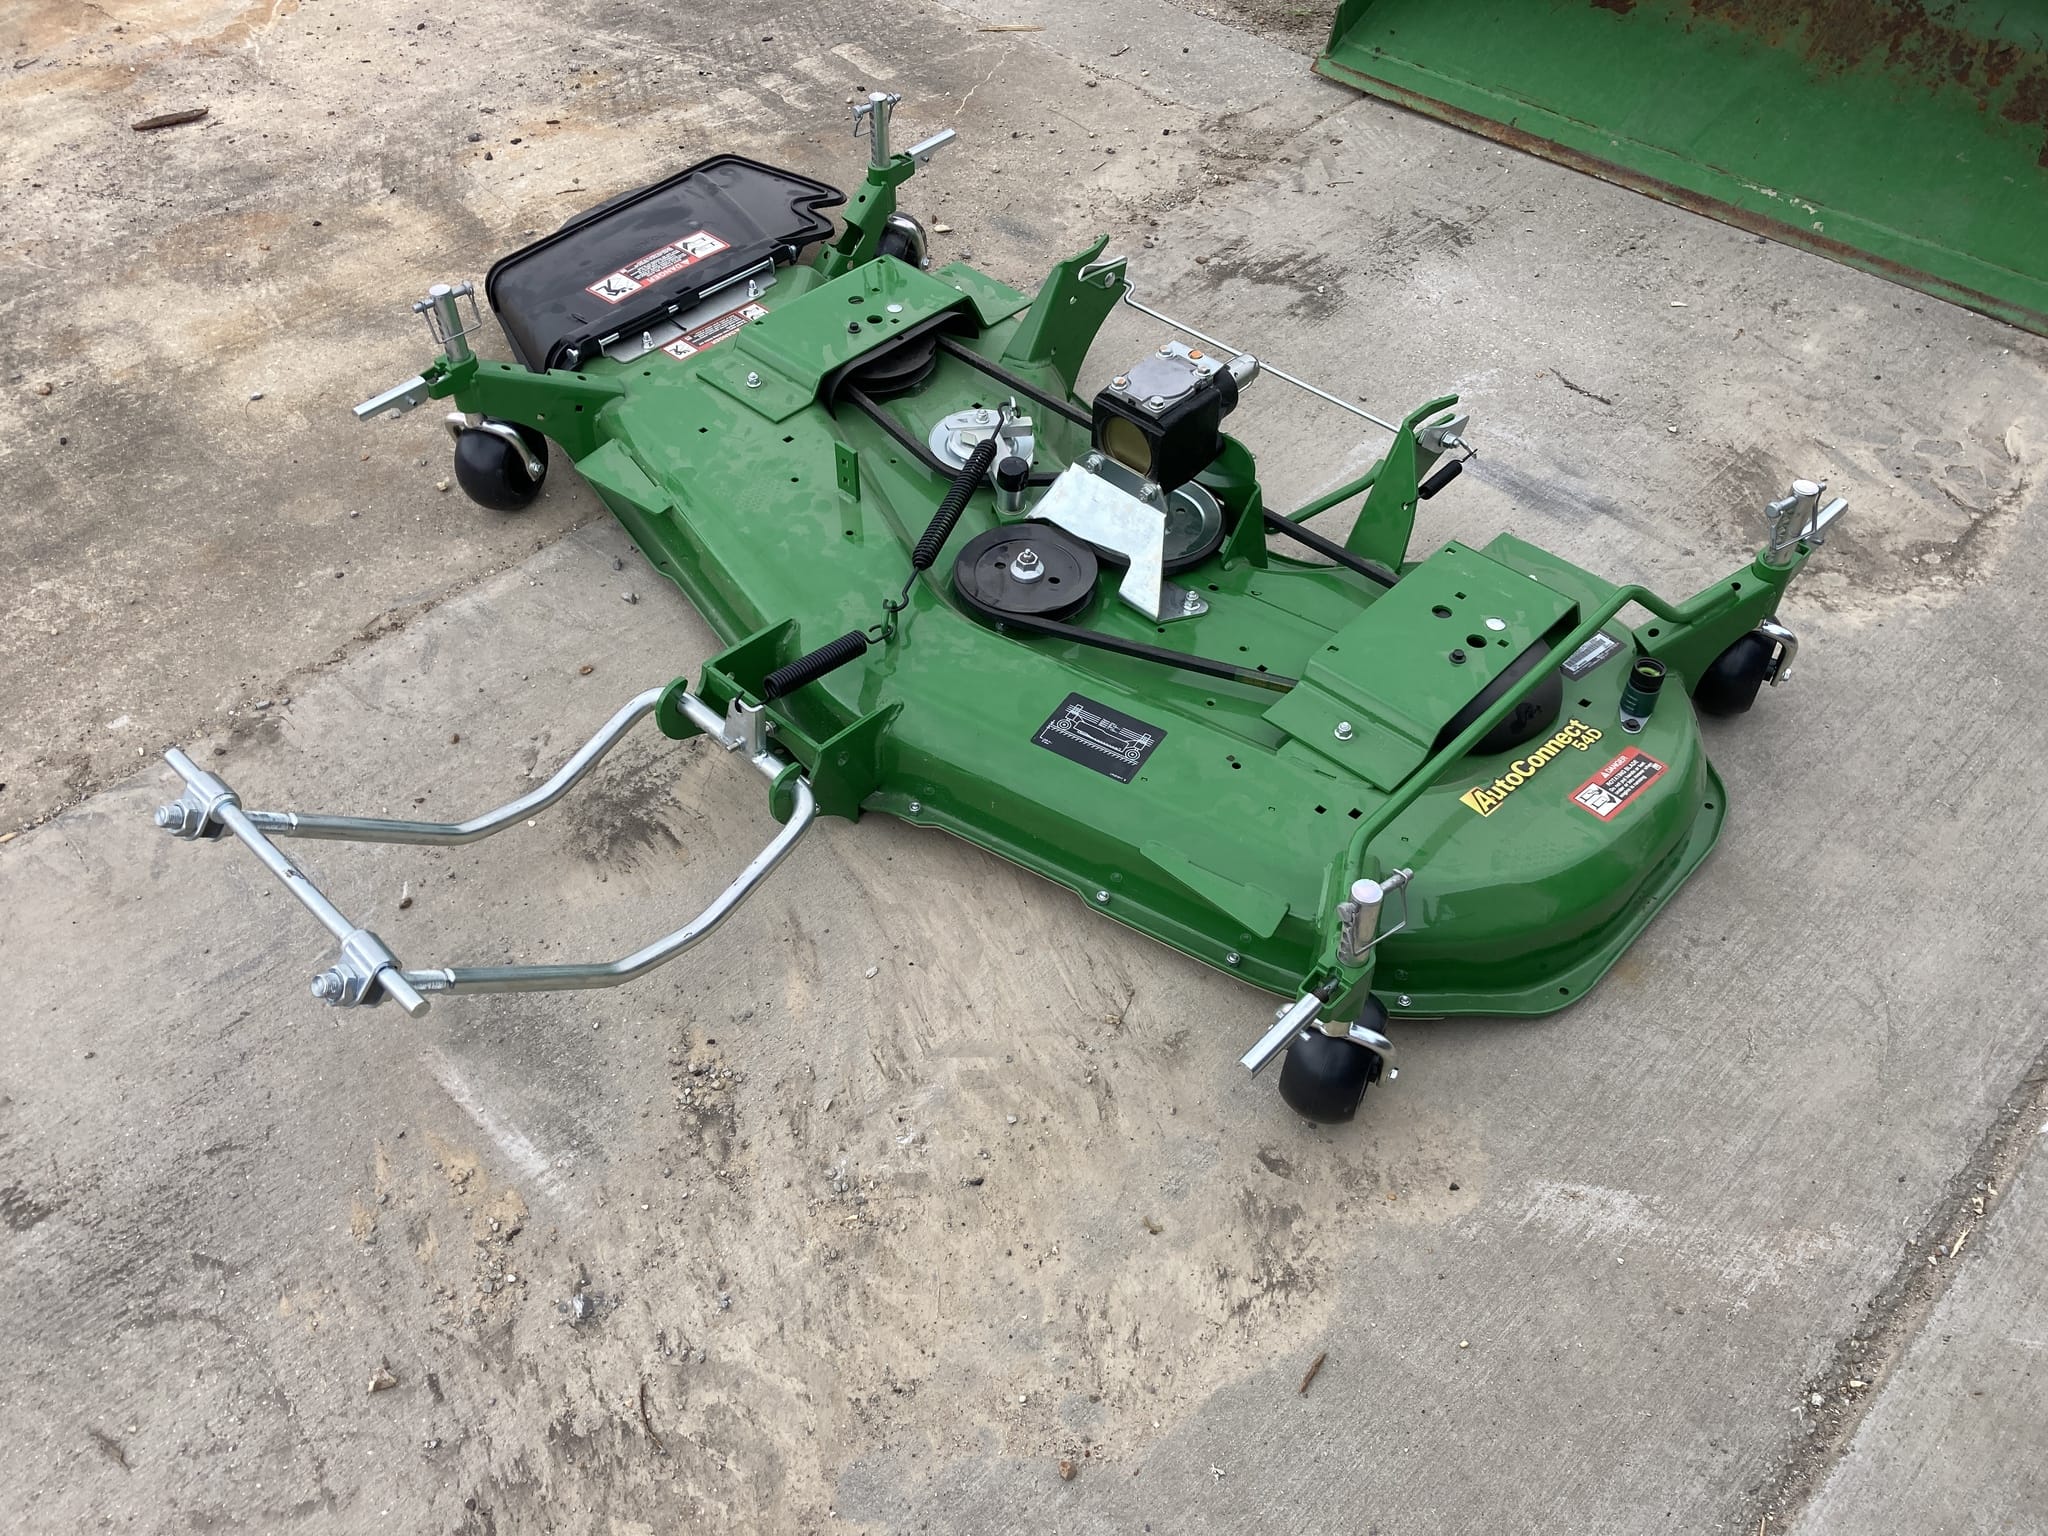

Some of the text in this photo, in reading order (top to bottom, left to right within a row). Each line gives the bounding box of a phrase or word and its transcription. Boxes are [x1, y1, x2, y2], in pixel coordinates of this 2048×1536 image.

[1571, 728, 1602, 751] 54D
[1474, 719, 1589, 812] AutoConnect
[1603, 754, 1629, 774] DANGER
